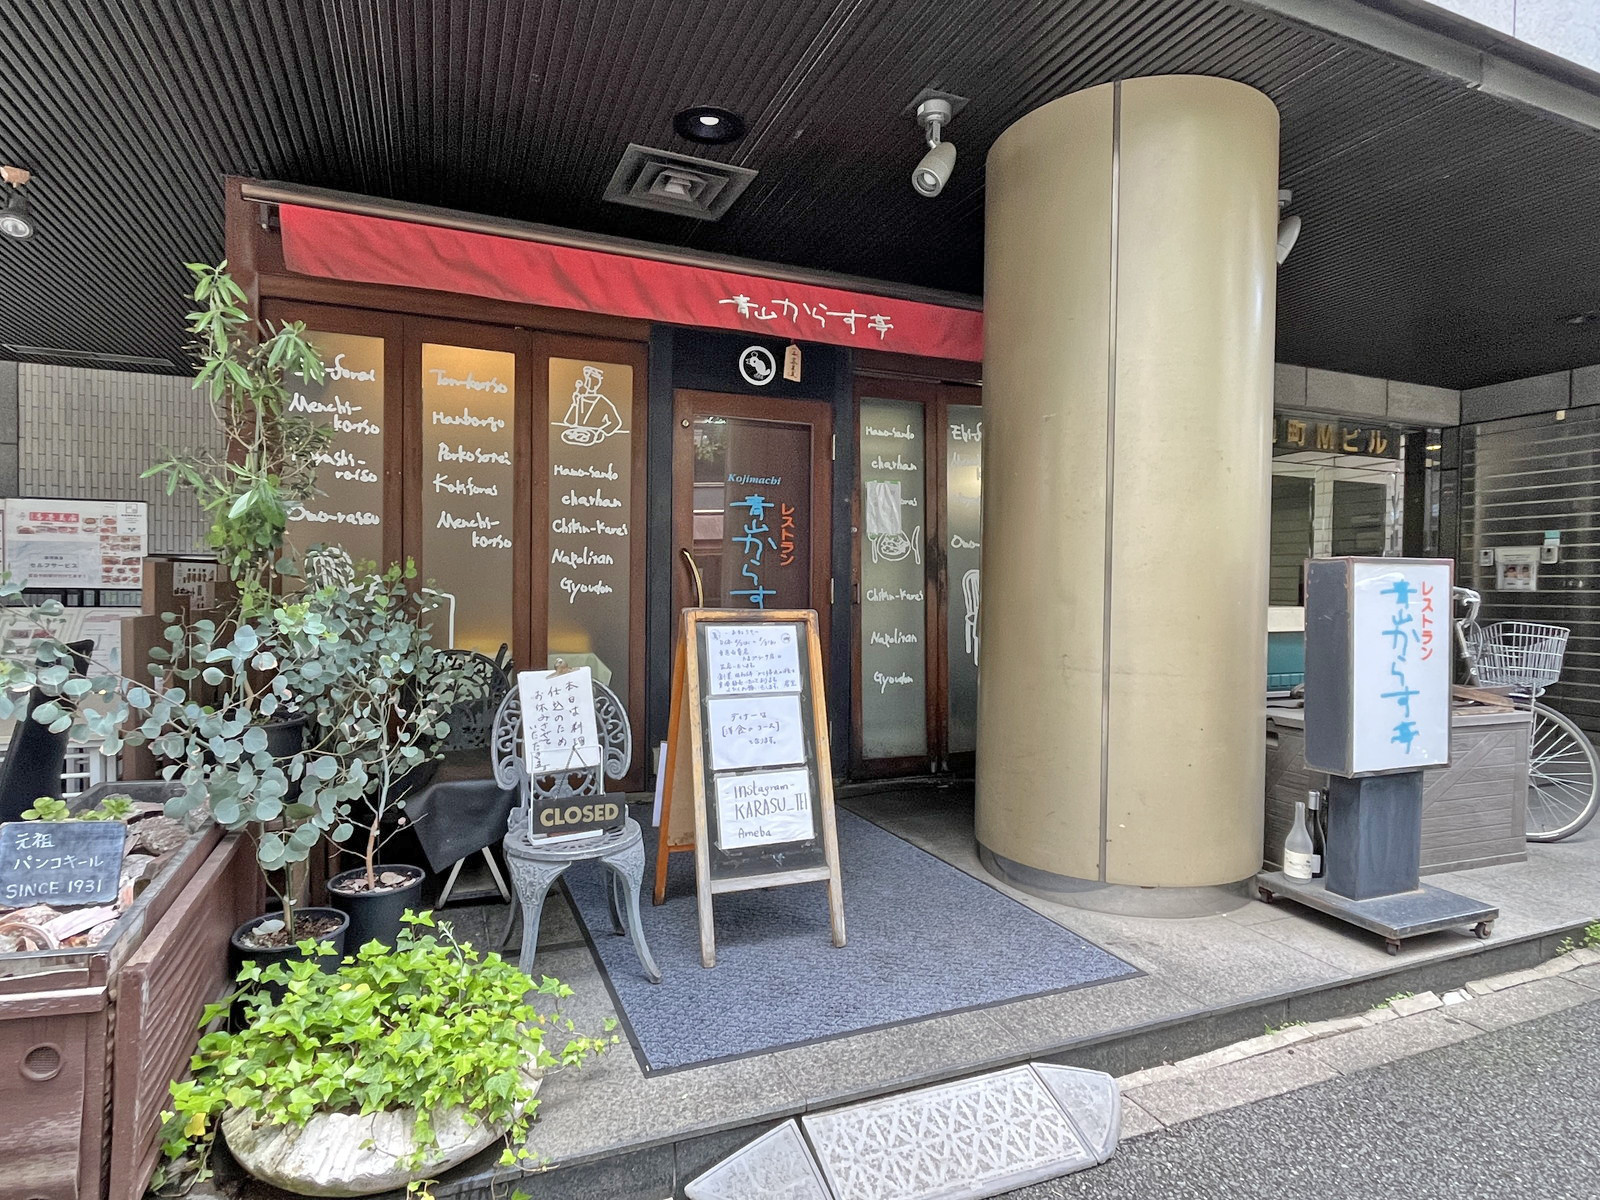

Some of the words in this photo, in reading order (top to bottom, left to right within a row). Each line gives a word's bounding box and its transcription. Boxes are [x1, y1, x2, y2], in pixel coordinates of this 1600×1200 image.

[718, 293, 895, 341] 青山からす亭
[727, 473, 782, 486] Kojimachi
[780, 502, 796, 567] レストラン
[1421, 581, 1434, 661] レストラン
[540, 803, 619, 827] CLOSED
[734, 792, 808, 821] KARASU_TEI
[15, 832, 55, 851] 元祖
[737, 825, 772, 840] Ameba
[13, 854, 105, 870] パンコキール
[5, 881, 59, 899] SINCE
[67, 879, 102, 894] 1931
